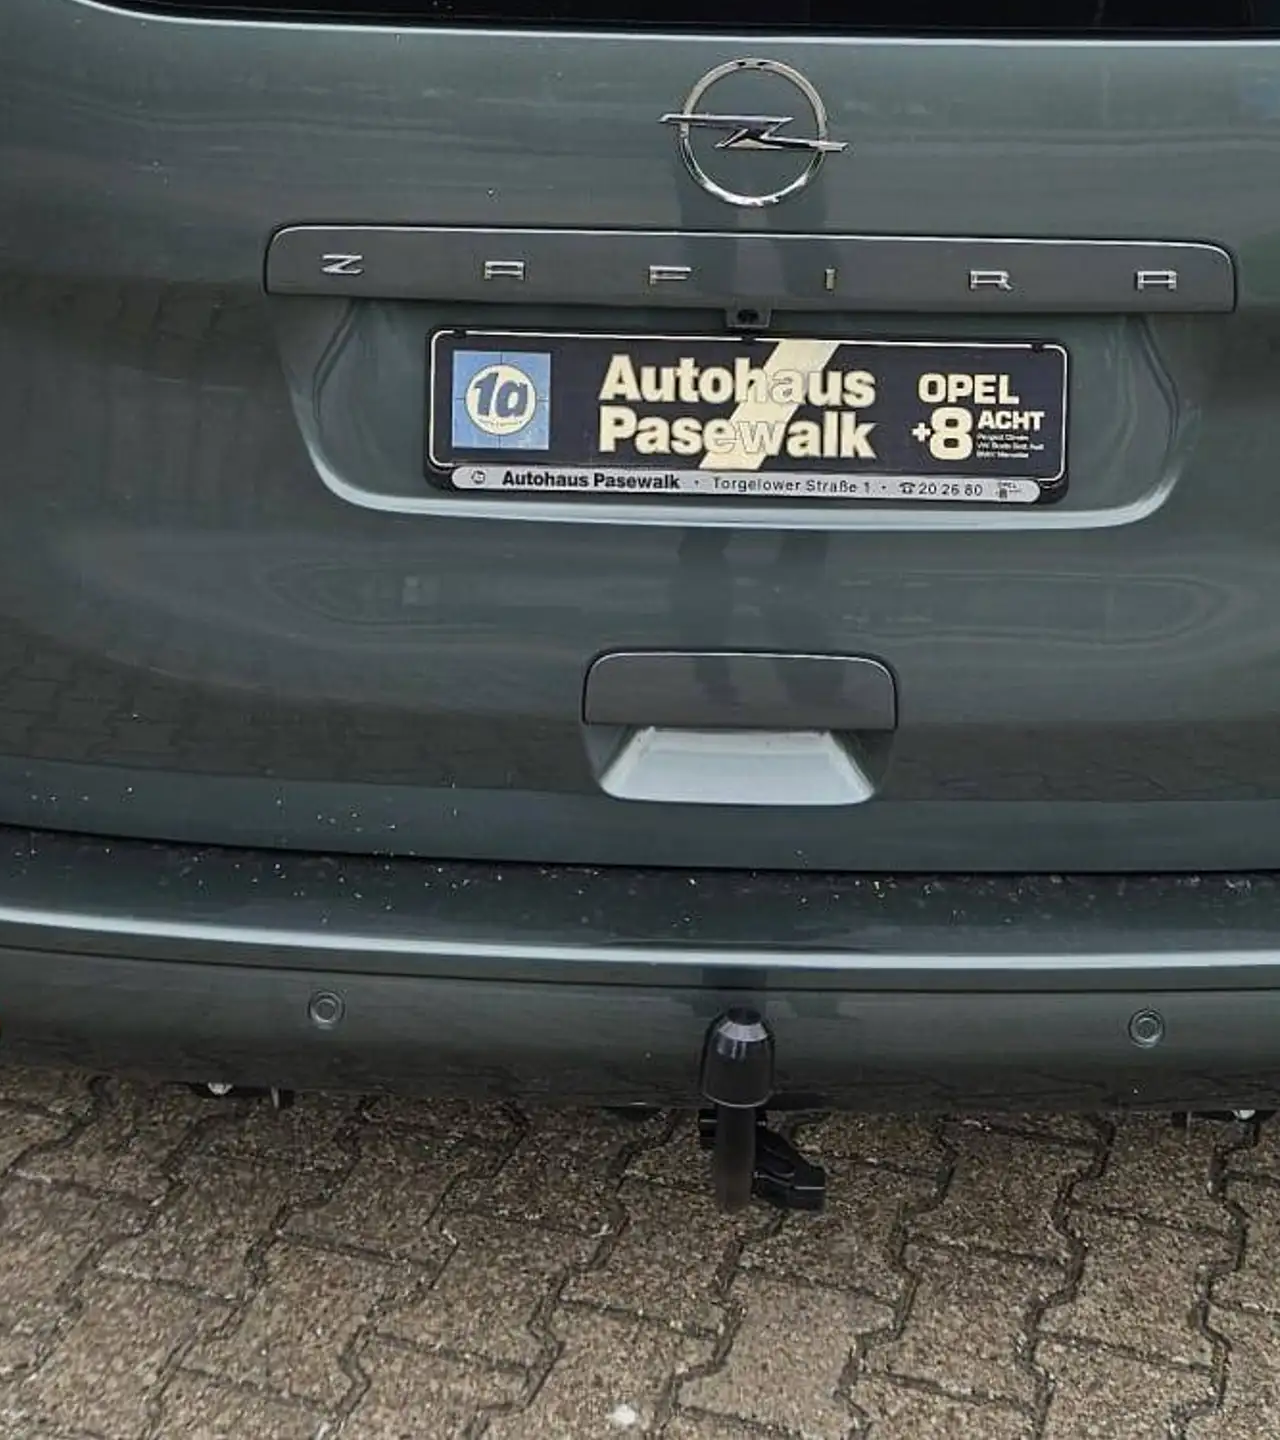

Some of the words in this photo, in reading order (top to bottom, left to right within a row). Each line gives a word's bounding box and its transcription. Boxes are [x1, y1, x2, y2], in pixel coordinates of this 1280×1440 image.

[322, 254, 1180, 291] ZAFIRA
[599, 353, 876, 407] Autohaus
[918, 373, 1020, 405] OPEL
[597, 406, 877, 461] Pasewalk
[978, 410, 1046, 431] ACHT
[502, 470, 588, 487] Autohaus
[593, 471, 680, 489] Pasewalk
[713, 476, 803, 493] Torgelower
[806, 479, 858, 494] Straße
[918, 482, 937, 496] 20
